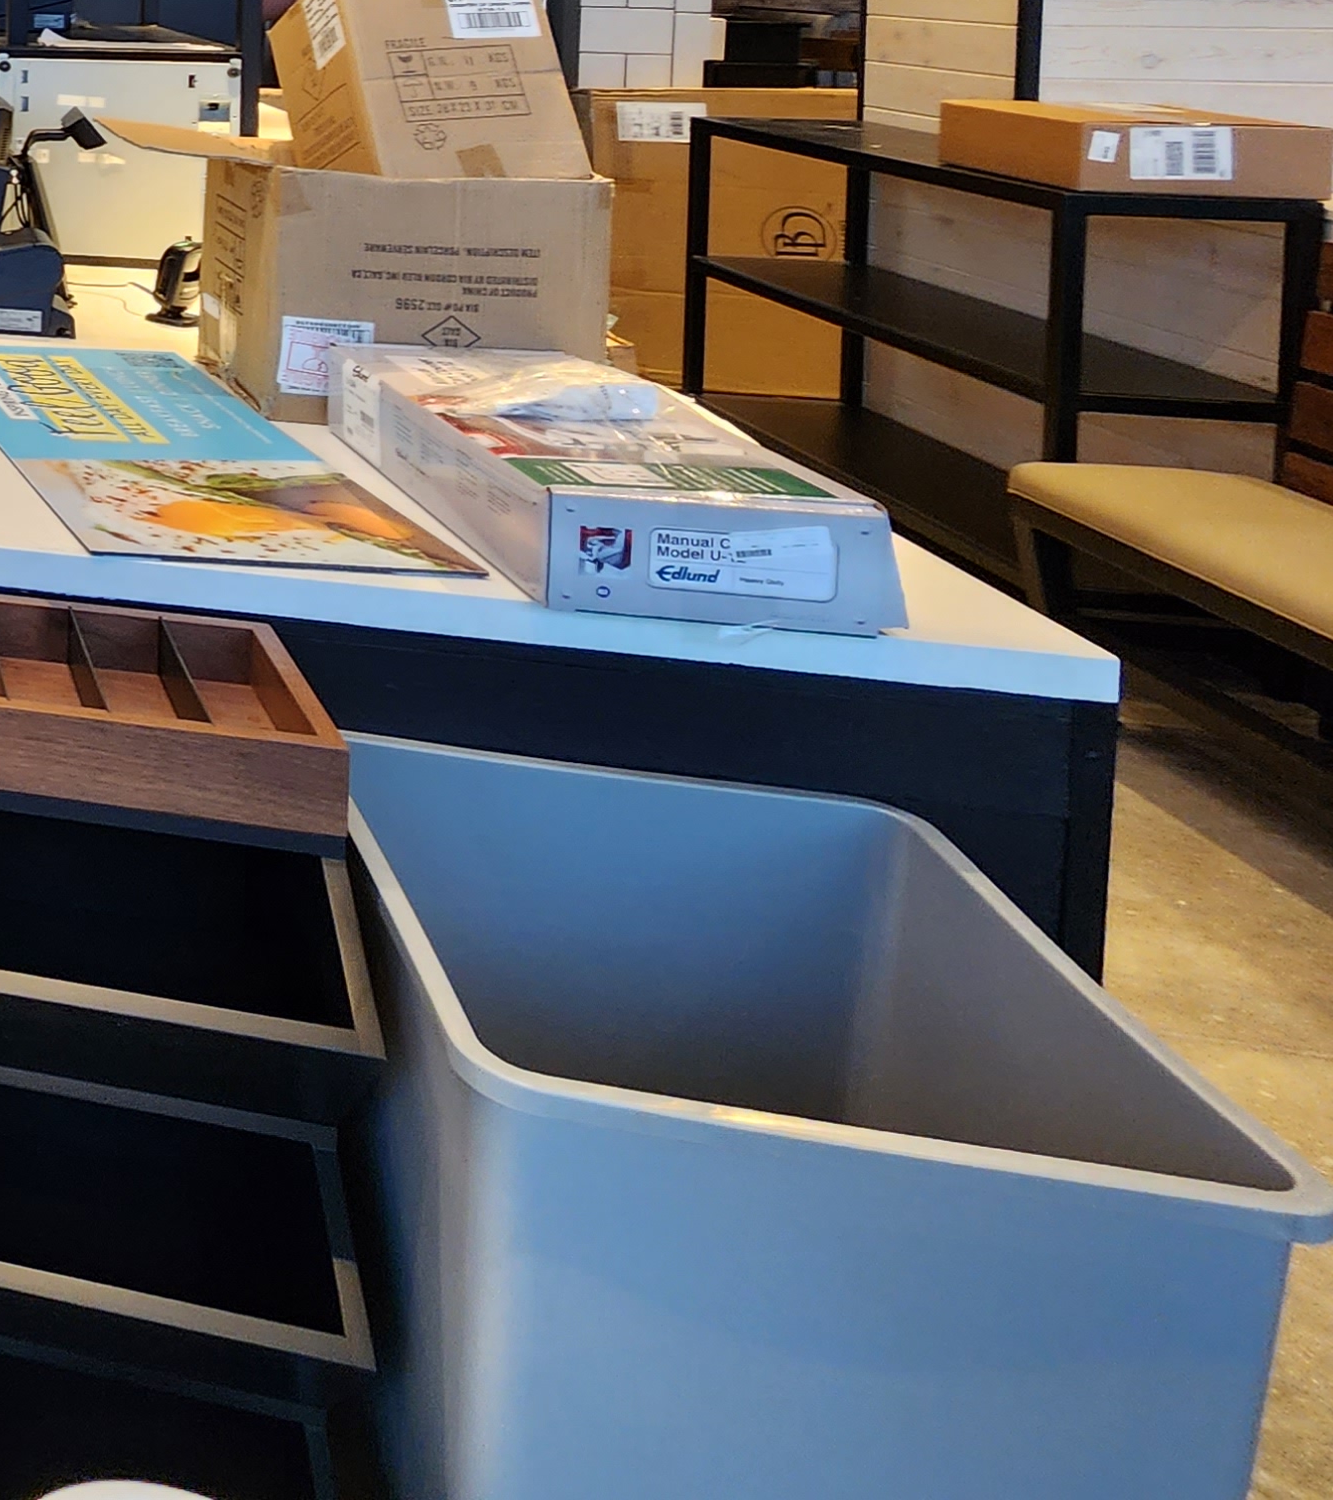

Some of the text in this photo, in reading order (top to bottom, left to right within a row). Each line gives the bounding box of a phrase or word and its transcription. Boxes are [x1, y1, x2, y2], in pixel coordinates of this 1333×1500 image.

[21, 400, 117, 436] Feel
[657, 533, 714, 547] Manual
[657, 546, 704, 560] Model
[656, 565, 720, 584] Edlund
